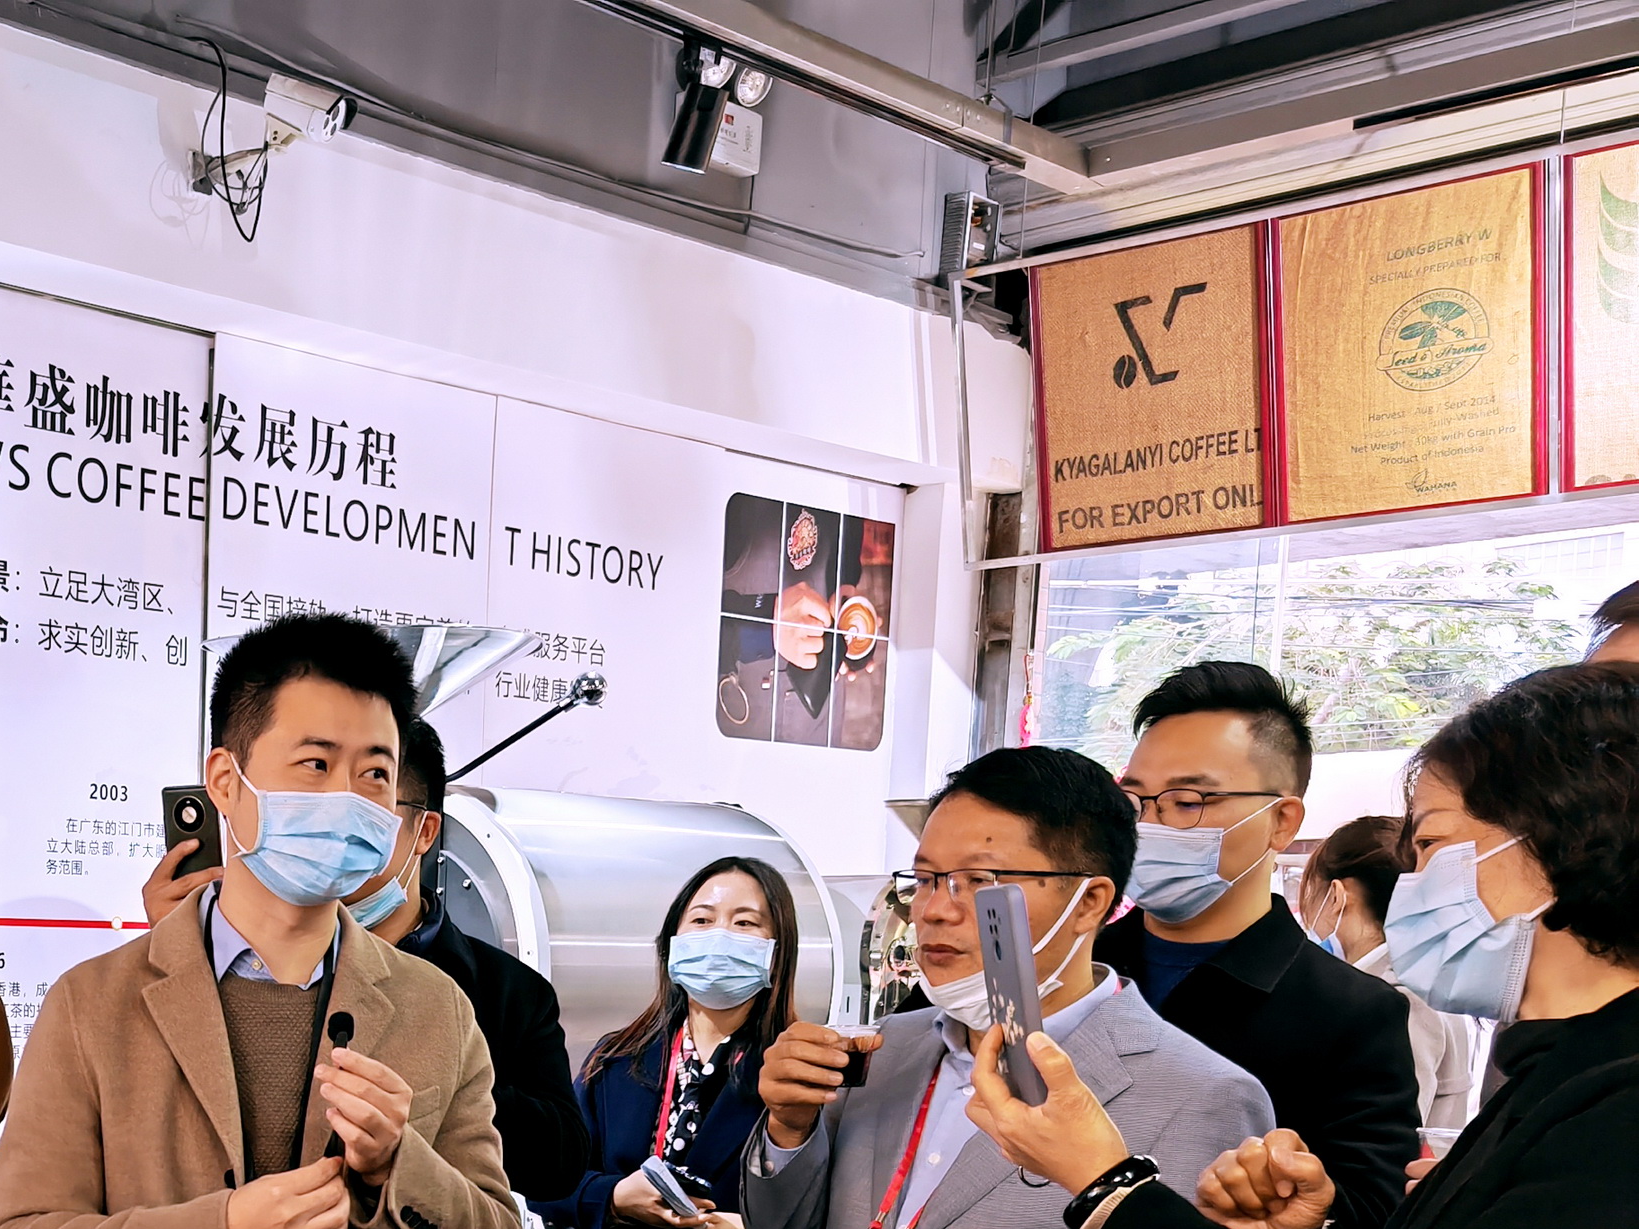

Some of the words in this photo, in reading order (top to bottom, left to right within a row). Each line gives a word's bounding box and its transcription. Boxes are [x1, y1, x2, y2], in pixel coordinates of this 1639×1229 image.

[1386, 232, 1473, 262] LONGBERRY
[1368, 410, 1406, 422] Harvest
[1467, 427, 1496, 439] Grain
[1498, 424, 1516, 435] Pro
[1053, 442, 1163, 484] KYAGALANYI
[1168, 429, 1239, 465] COFFEE
[1380, 453, 1418, 466] Product
[46, 451, 206, 522] COFFEE
[1057, 505, 1105, 535] FOR
[1110, 489, 1205, 528] EXPORT
[89, 783, 129, 802] 2003
